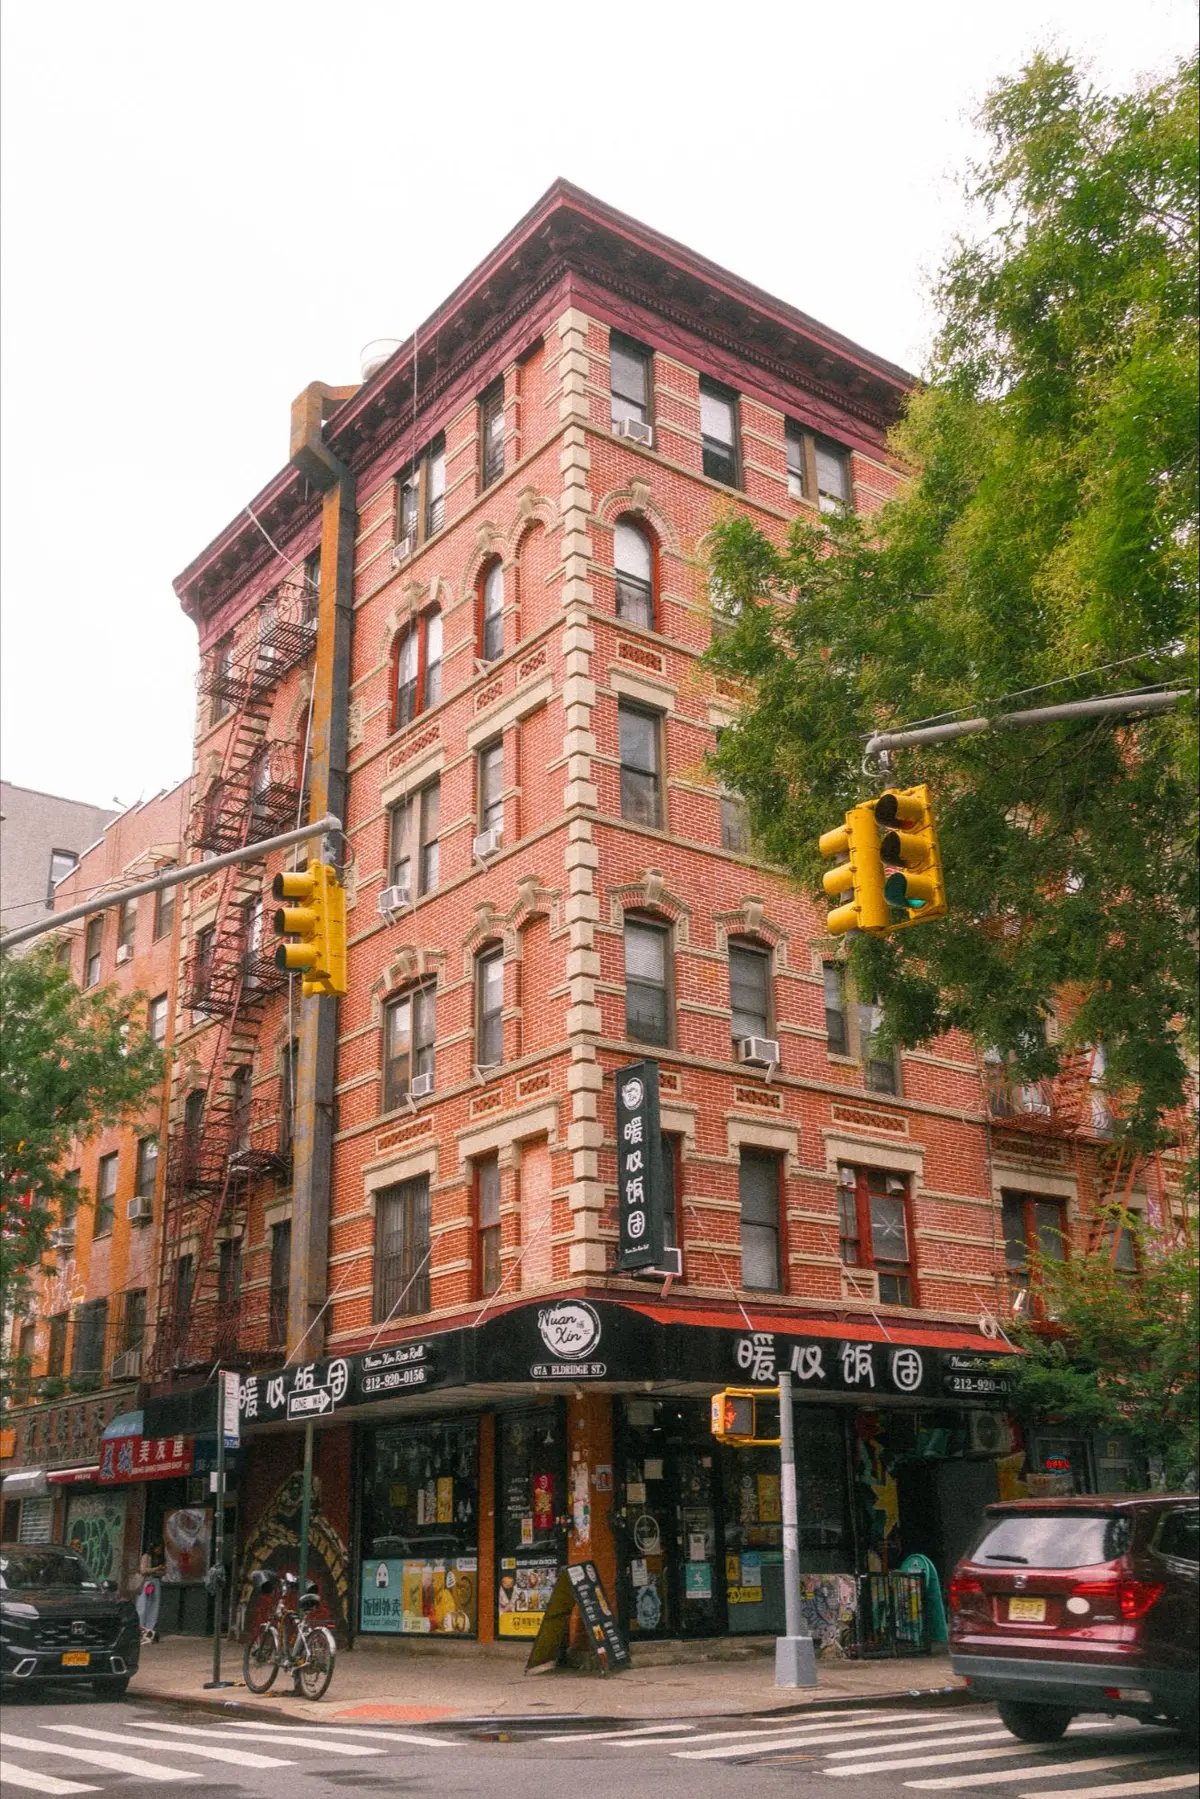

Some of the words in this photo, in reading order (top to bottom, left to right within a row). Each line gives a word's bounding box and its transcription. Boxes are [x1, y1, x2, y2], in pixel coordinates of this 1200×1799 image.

[624, 1116, 646, 1238] 暖心饭团
[539, 1310, 577, 1327] Nuan
[555, 1327, 582, 1345] Xin
[409, 1345, 424, 1359] Roll
[533, 1365, 548, 1376] 67A
[551, 1365, 589, 1375] ELDRIDGE
[591, 1364, 603, 1374] ST.
[737, 1333, 923, 1391] 暖心饭团
[953, 1377, 1013, 1392] 212-920-01
[294, 1398, 308, 1410] ONE
[312, 1393, 327, 1406] WAY
[1045, 1459, 1070, 1470] OPEN
